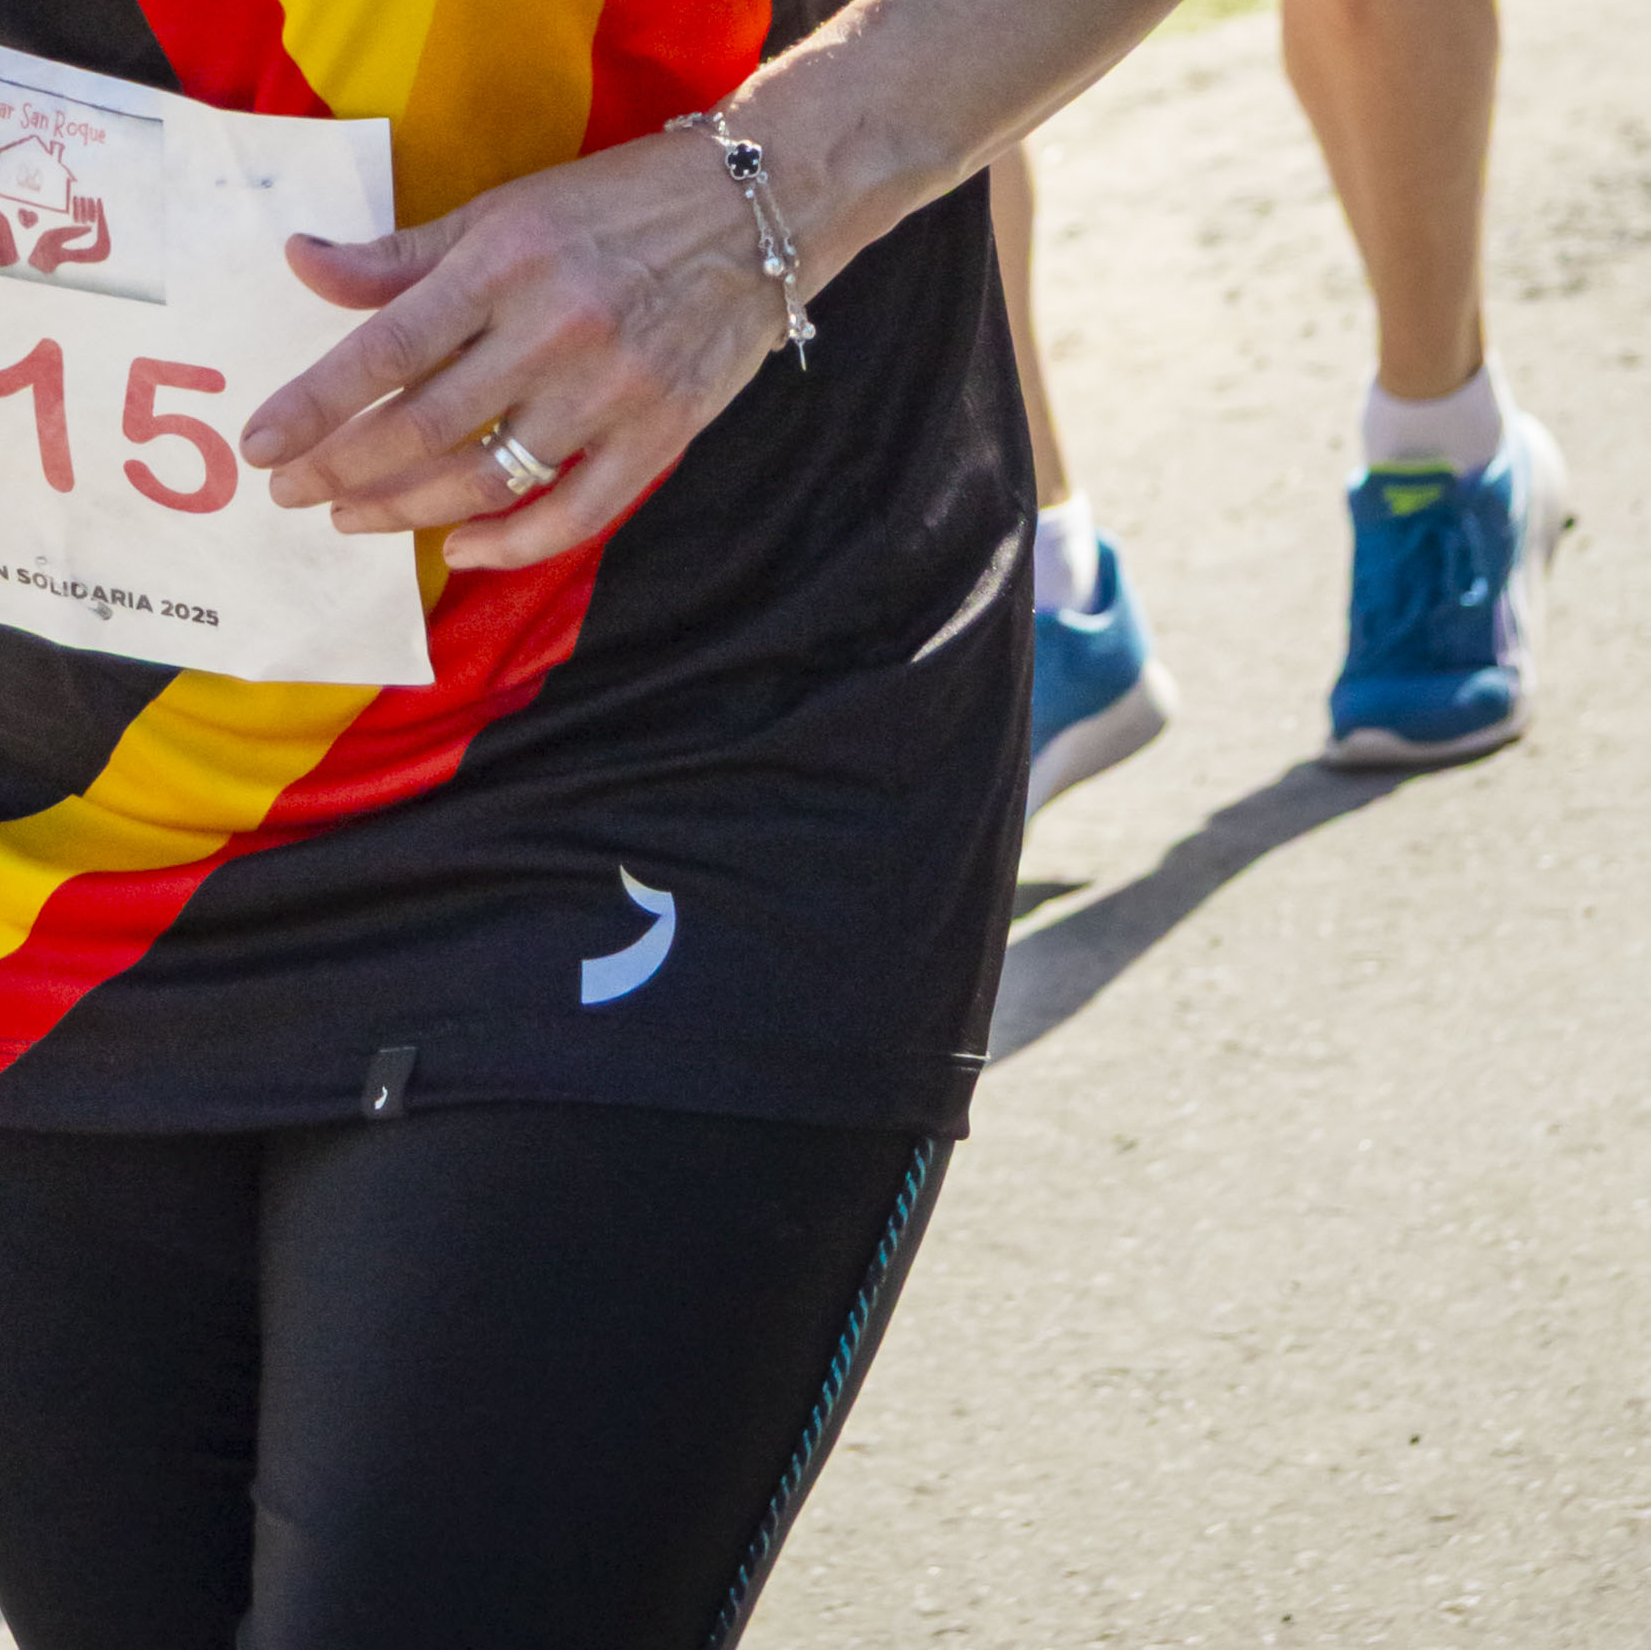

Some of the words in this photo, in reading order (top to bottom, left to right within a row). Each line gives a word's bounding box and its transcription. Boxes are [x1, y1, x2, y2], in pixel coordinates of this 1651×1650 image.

[20, 102, 49, 130] San
[53, 109, 107, 146] Roque
[15, 566, 154, 613] SOLIDARIA
[160, 598, 220, 627] 2025
